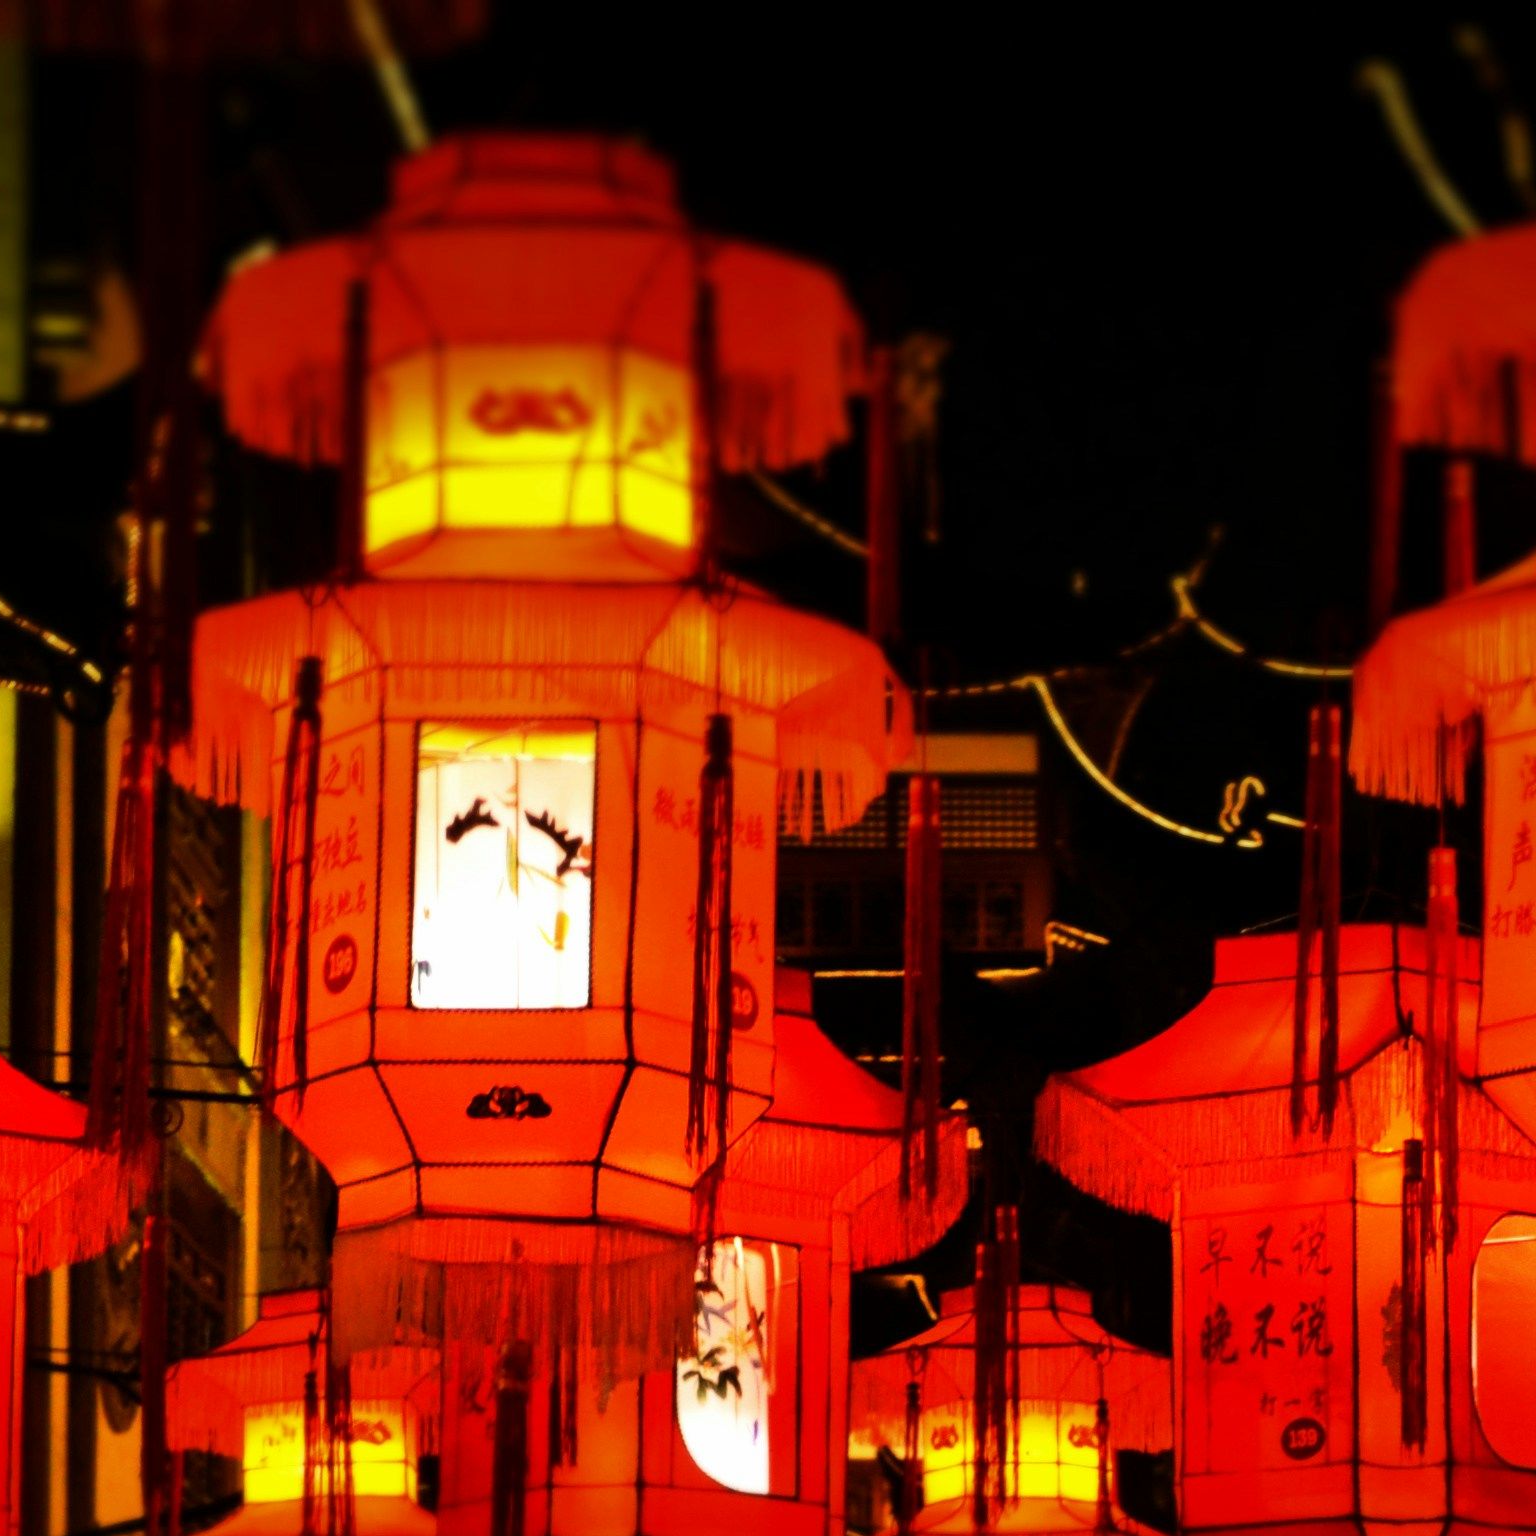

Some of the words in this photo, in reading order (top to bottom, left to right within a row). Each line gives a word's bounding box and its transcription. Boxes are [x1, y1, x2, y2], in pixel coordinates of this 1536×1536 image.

[1199, 1214, 1335, 1288] 早不说
[1199, 1295, 1335, 1365] 晚不说
[1288, 1428, 1318, 1449] 139
